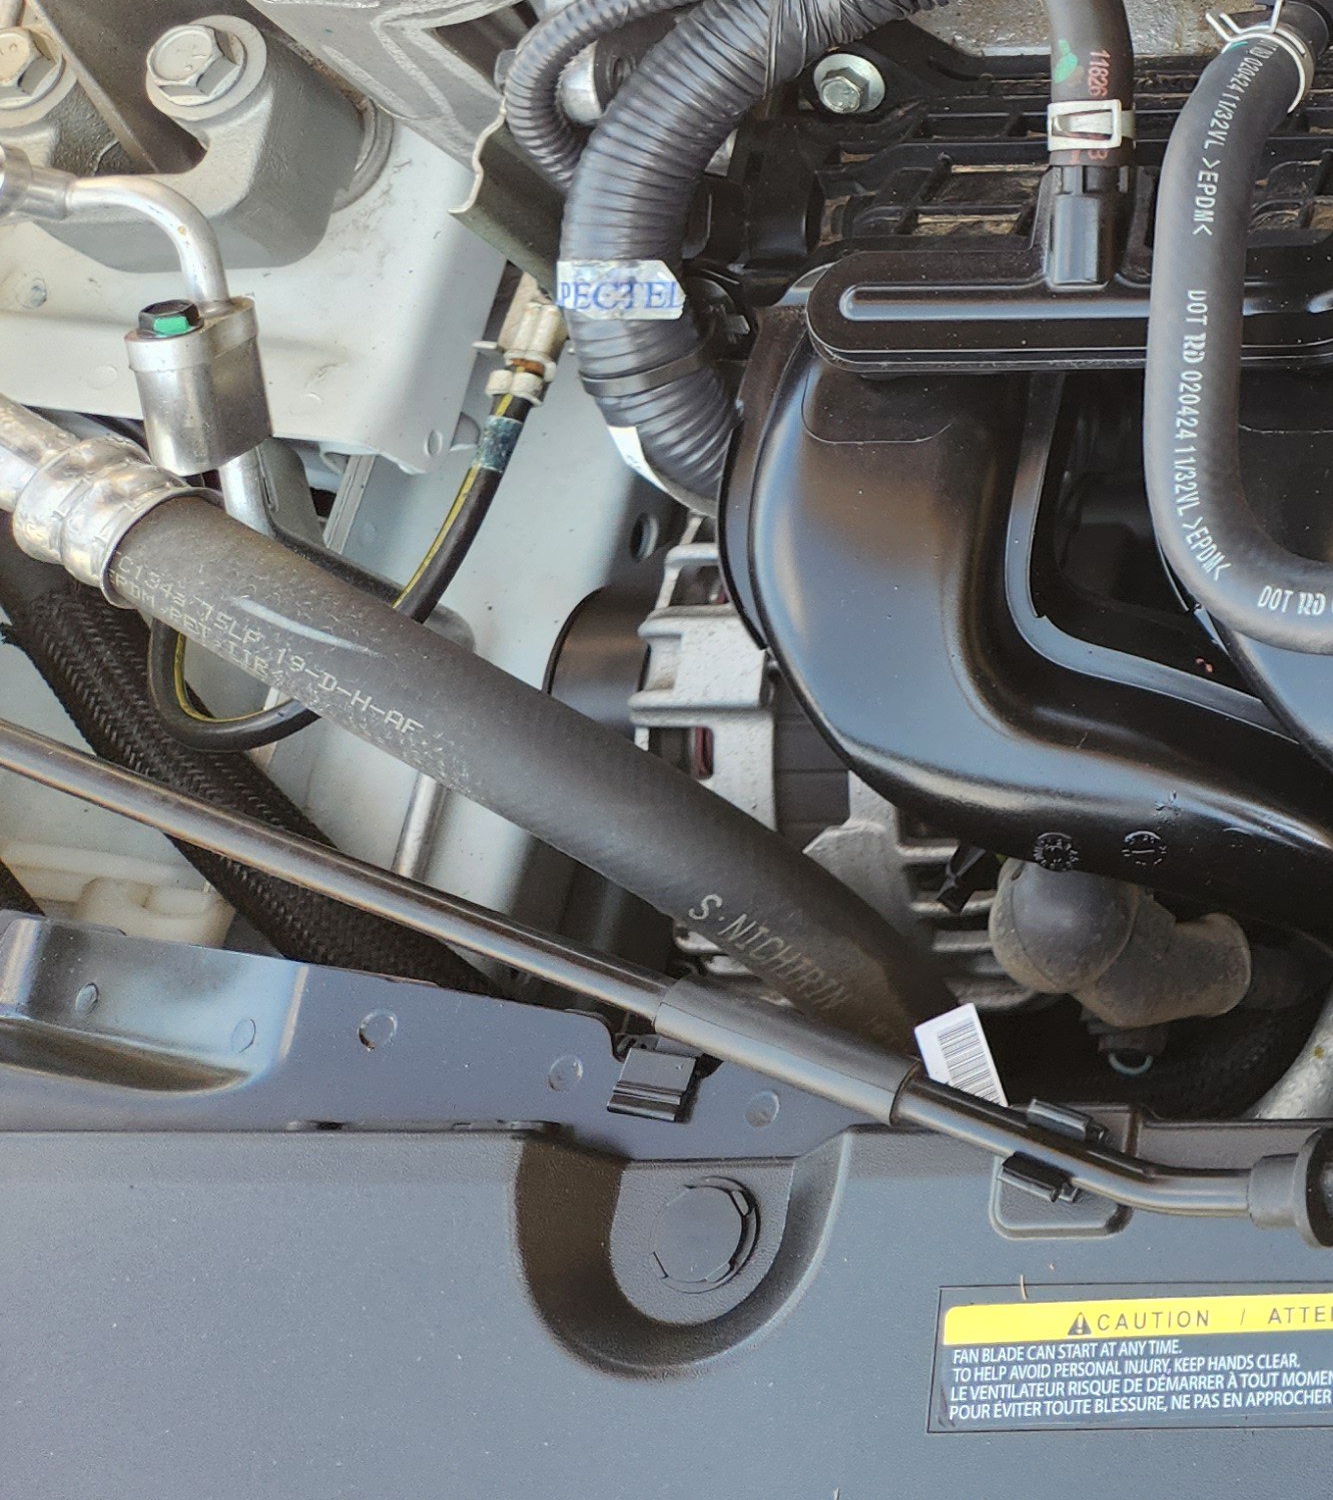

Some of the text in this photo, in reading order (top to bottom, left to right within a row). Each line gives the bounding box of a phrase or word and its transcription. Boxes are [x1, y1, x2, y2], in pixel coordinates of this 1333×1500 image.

[1185, 289, 1208, 325] DOT
[1175, 371, 1204, 440] 020424
[1257, 585, 1294, 612] DOT
[1097, 1309, 1209, 1332] CAUTION
[953, 1339, 1183, 1364] FAN BLADE CAN START AT ANY TIME.
[953, 1352, 1300, 1383] TO HELP AVOID PERSONAL INJURY, KEEP HANDS CLEAR.
[951, 1387, 968, 1402] LE
[970, 1382, 1065, 1401] VENTILATEUR
[1068, 1379, 1119, 1398] RISQUE
[1121, 1377, 1143, 1393] DE
[1145, 1373, 1225, 1392] DÉMARRER
[1227, 1371, 1238, 1389] À
[1240, 1372, 1278, 1388] TOUT
[949, 1404, 990, 1420] POUR
[993, 1398, 1041, 1418] ÉVITER
[1044, 1398, 1091, 1415] TOUTE
[1094, 1394, 1167, 1414] BLESSURE,
[1171, 1394, 1191, 1410] NE
[1193, 1392, 1220, 1409] PAS
[1223, 1391, 1243, 1408] EN
[1245, 1388, 1332, 1407] APPROCHER
